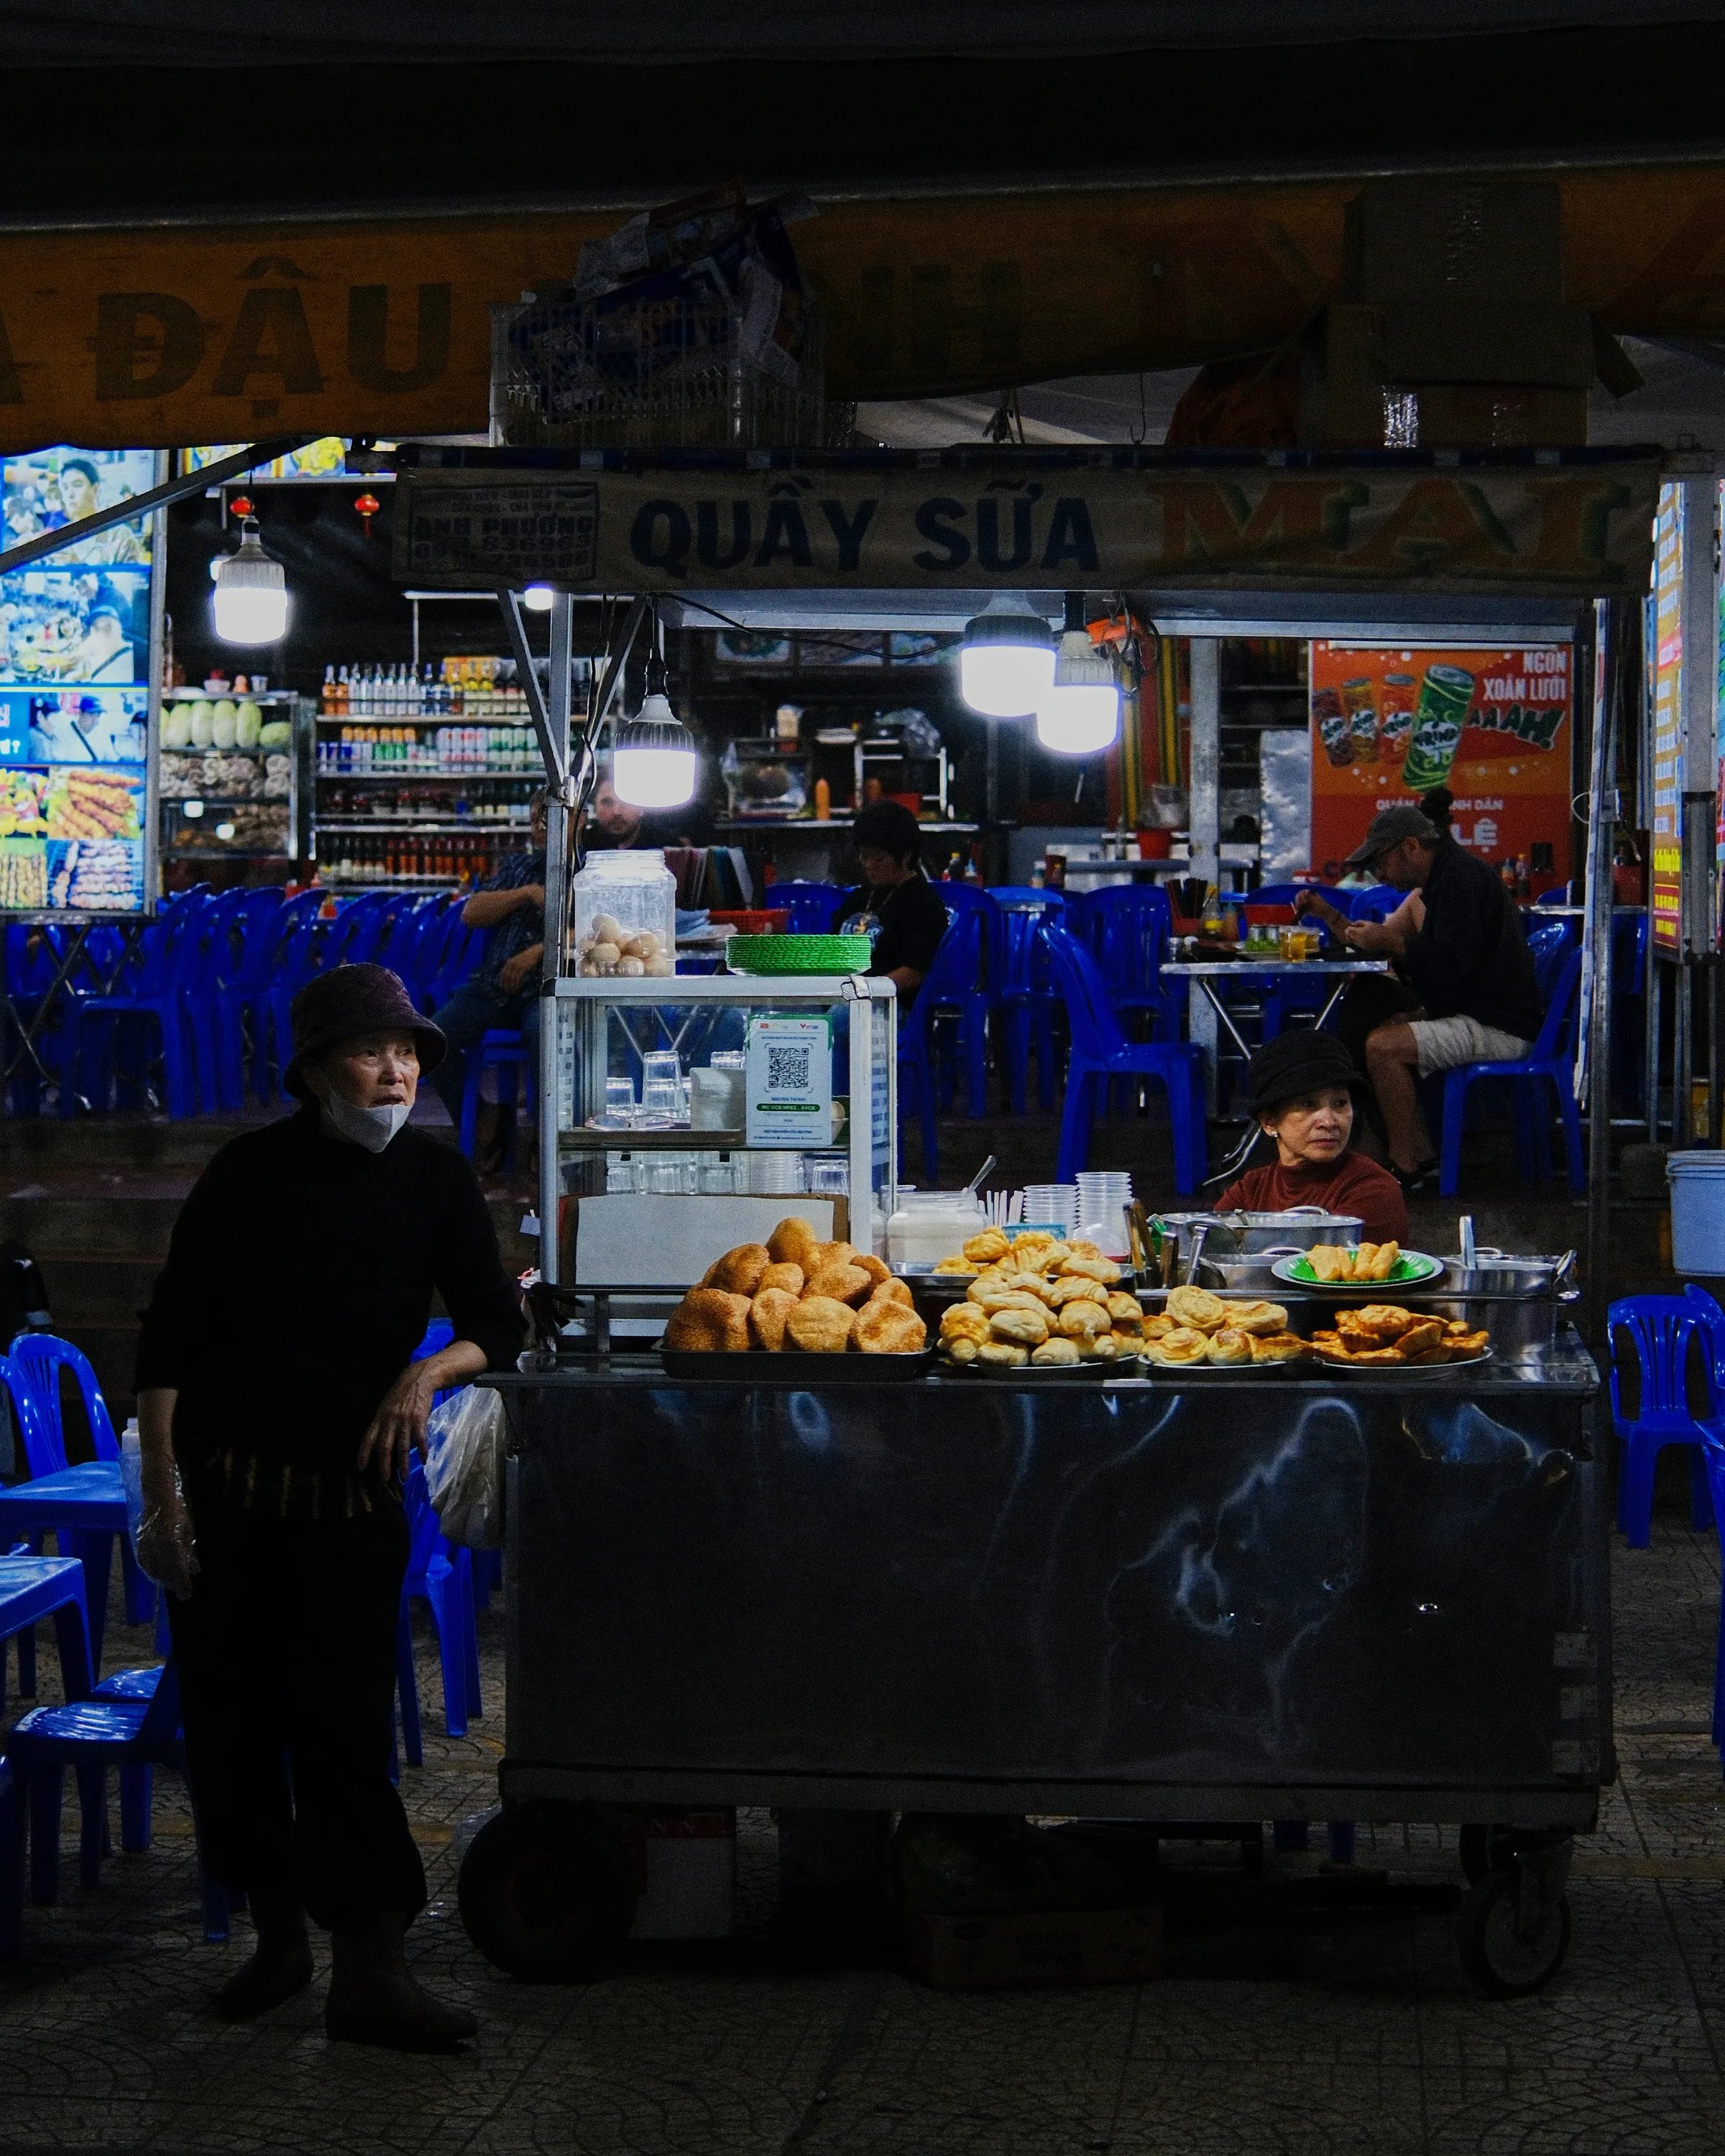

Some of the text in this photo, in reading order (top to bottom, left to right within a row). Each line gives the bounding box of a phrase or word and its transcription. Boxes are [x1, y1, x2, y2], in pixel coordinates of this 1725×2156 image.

[87, 255, 453, 418] ĐẬU
[630, 475, 878, 579] QUẦY
[912, 479, 1101, 573] SỮA
[1141, 478, 1630, 583] MAI
[1523, 651, 1566, 673] NGON
